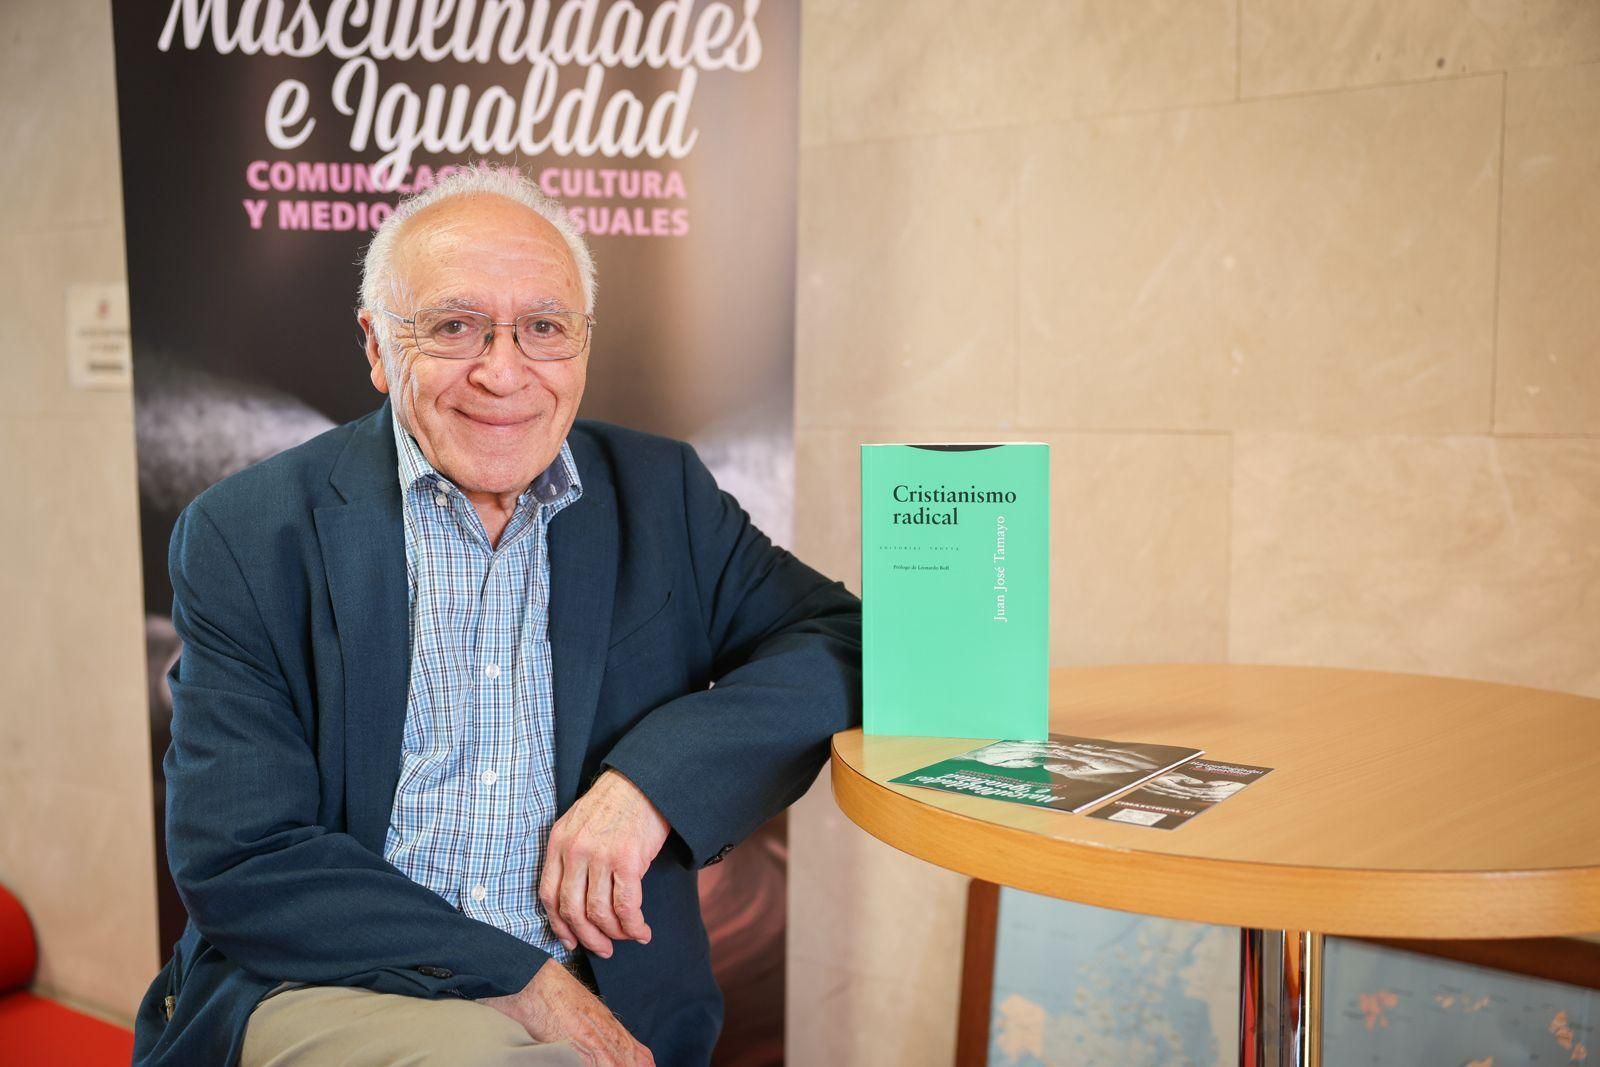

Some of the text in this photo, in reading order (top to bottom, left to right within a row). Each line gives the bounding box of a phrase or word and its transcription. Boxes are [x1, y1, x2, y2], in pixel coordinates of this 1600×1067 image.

[157, 0, 763, 72] Masculinidades
[265, 56, 700, 193] e Igualdad
[539, 168, 687, 198] CULTURA
[242, 199, 268, 230] Y
[278, 200, 404, 231] MEDIO
[893, 485, 1017, 504] Cristianismo
[893, 507, 959, 525] radical
[993, 515, 1008, 622] Juan José Tamayo
